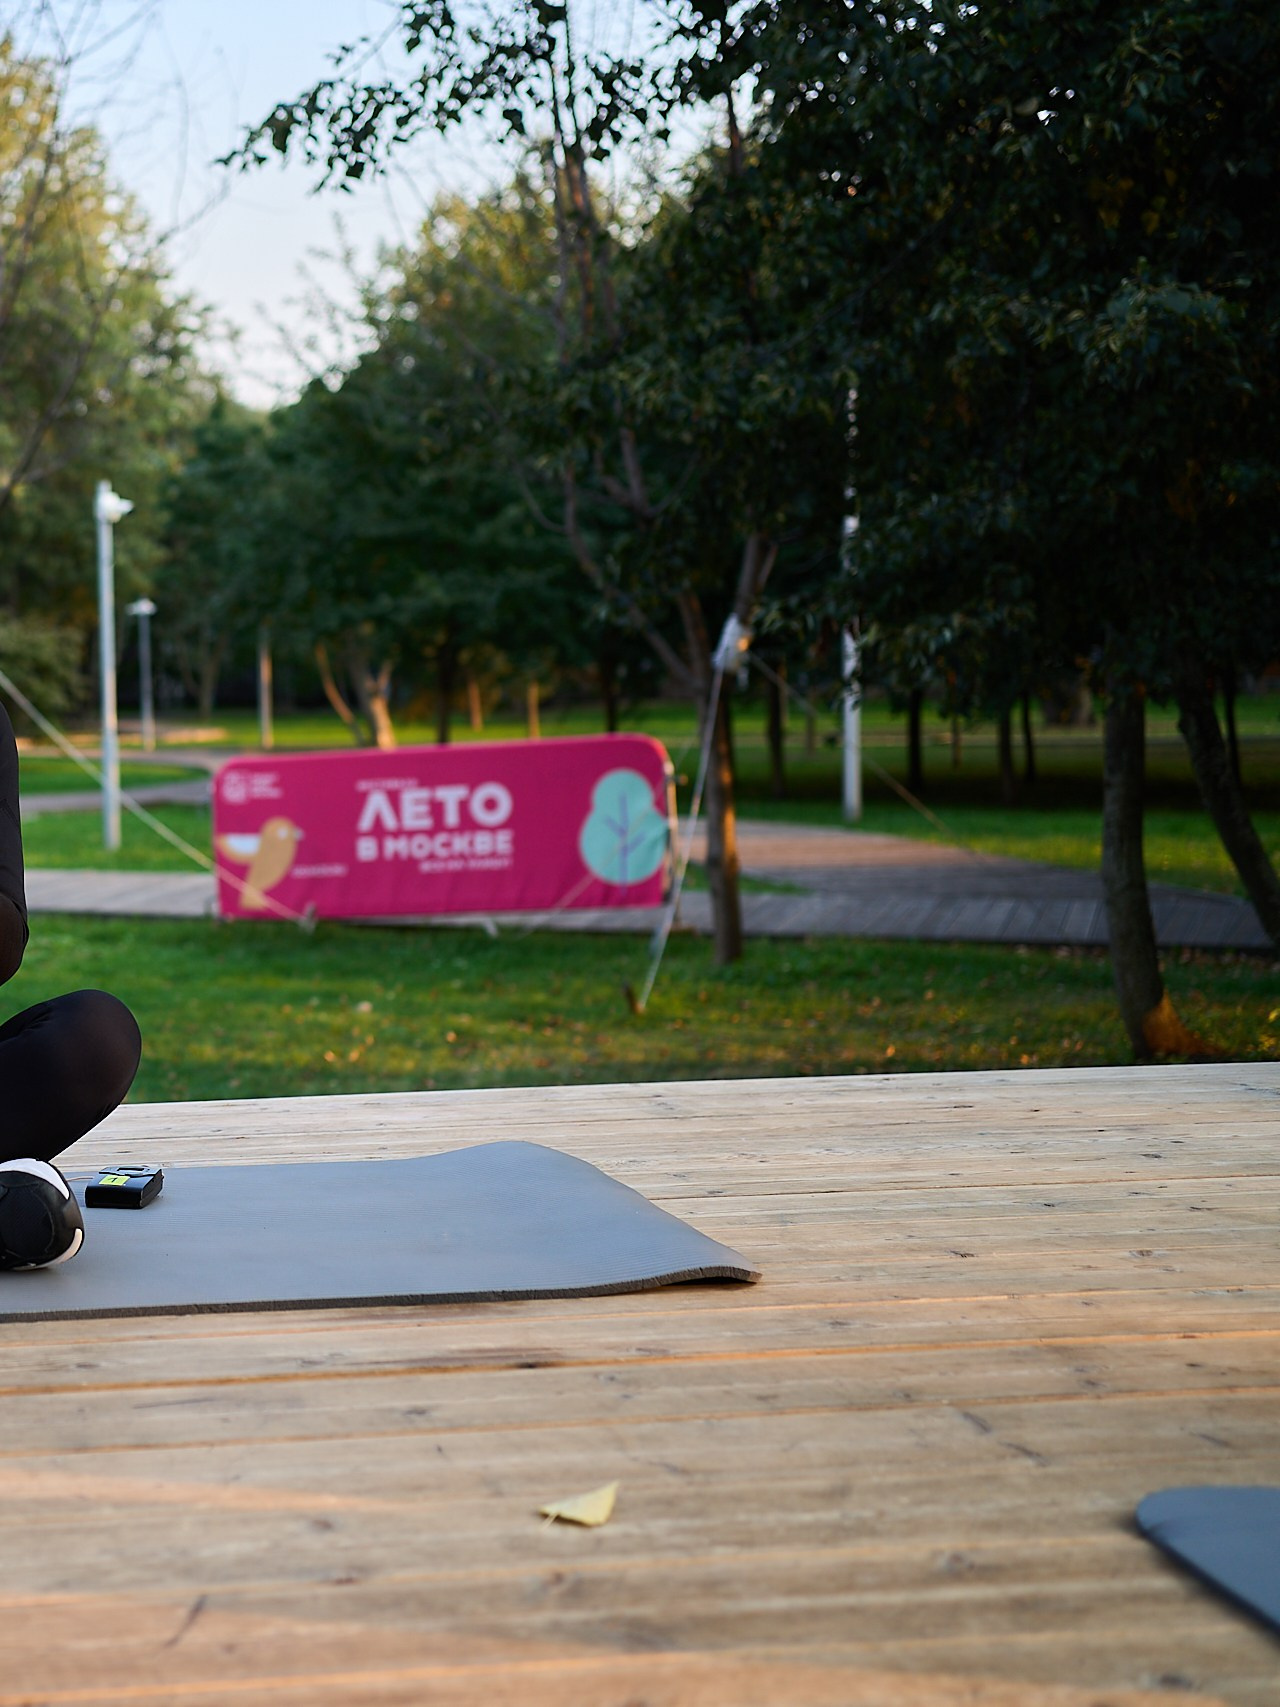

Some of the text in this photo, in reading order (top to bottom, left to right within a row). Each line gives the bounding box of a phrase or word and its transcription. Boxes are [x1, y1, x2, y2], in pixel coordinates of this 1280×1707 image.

[357, 781, 513, 832] ЛЕТО
[357, 830, 514, 862] В МОСКВЕ
